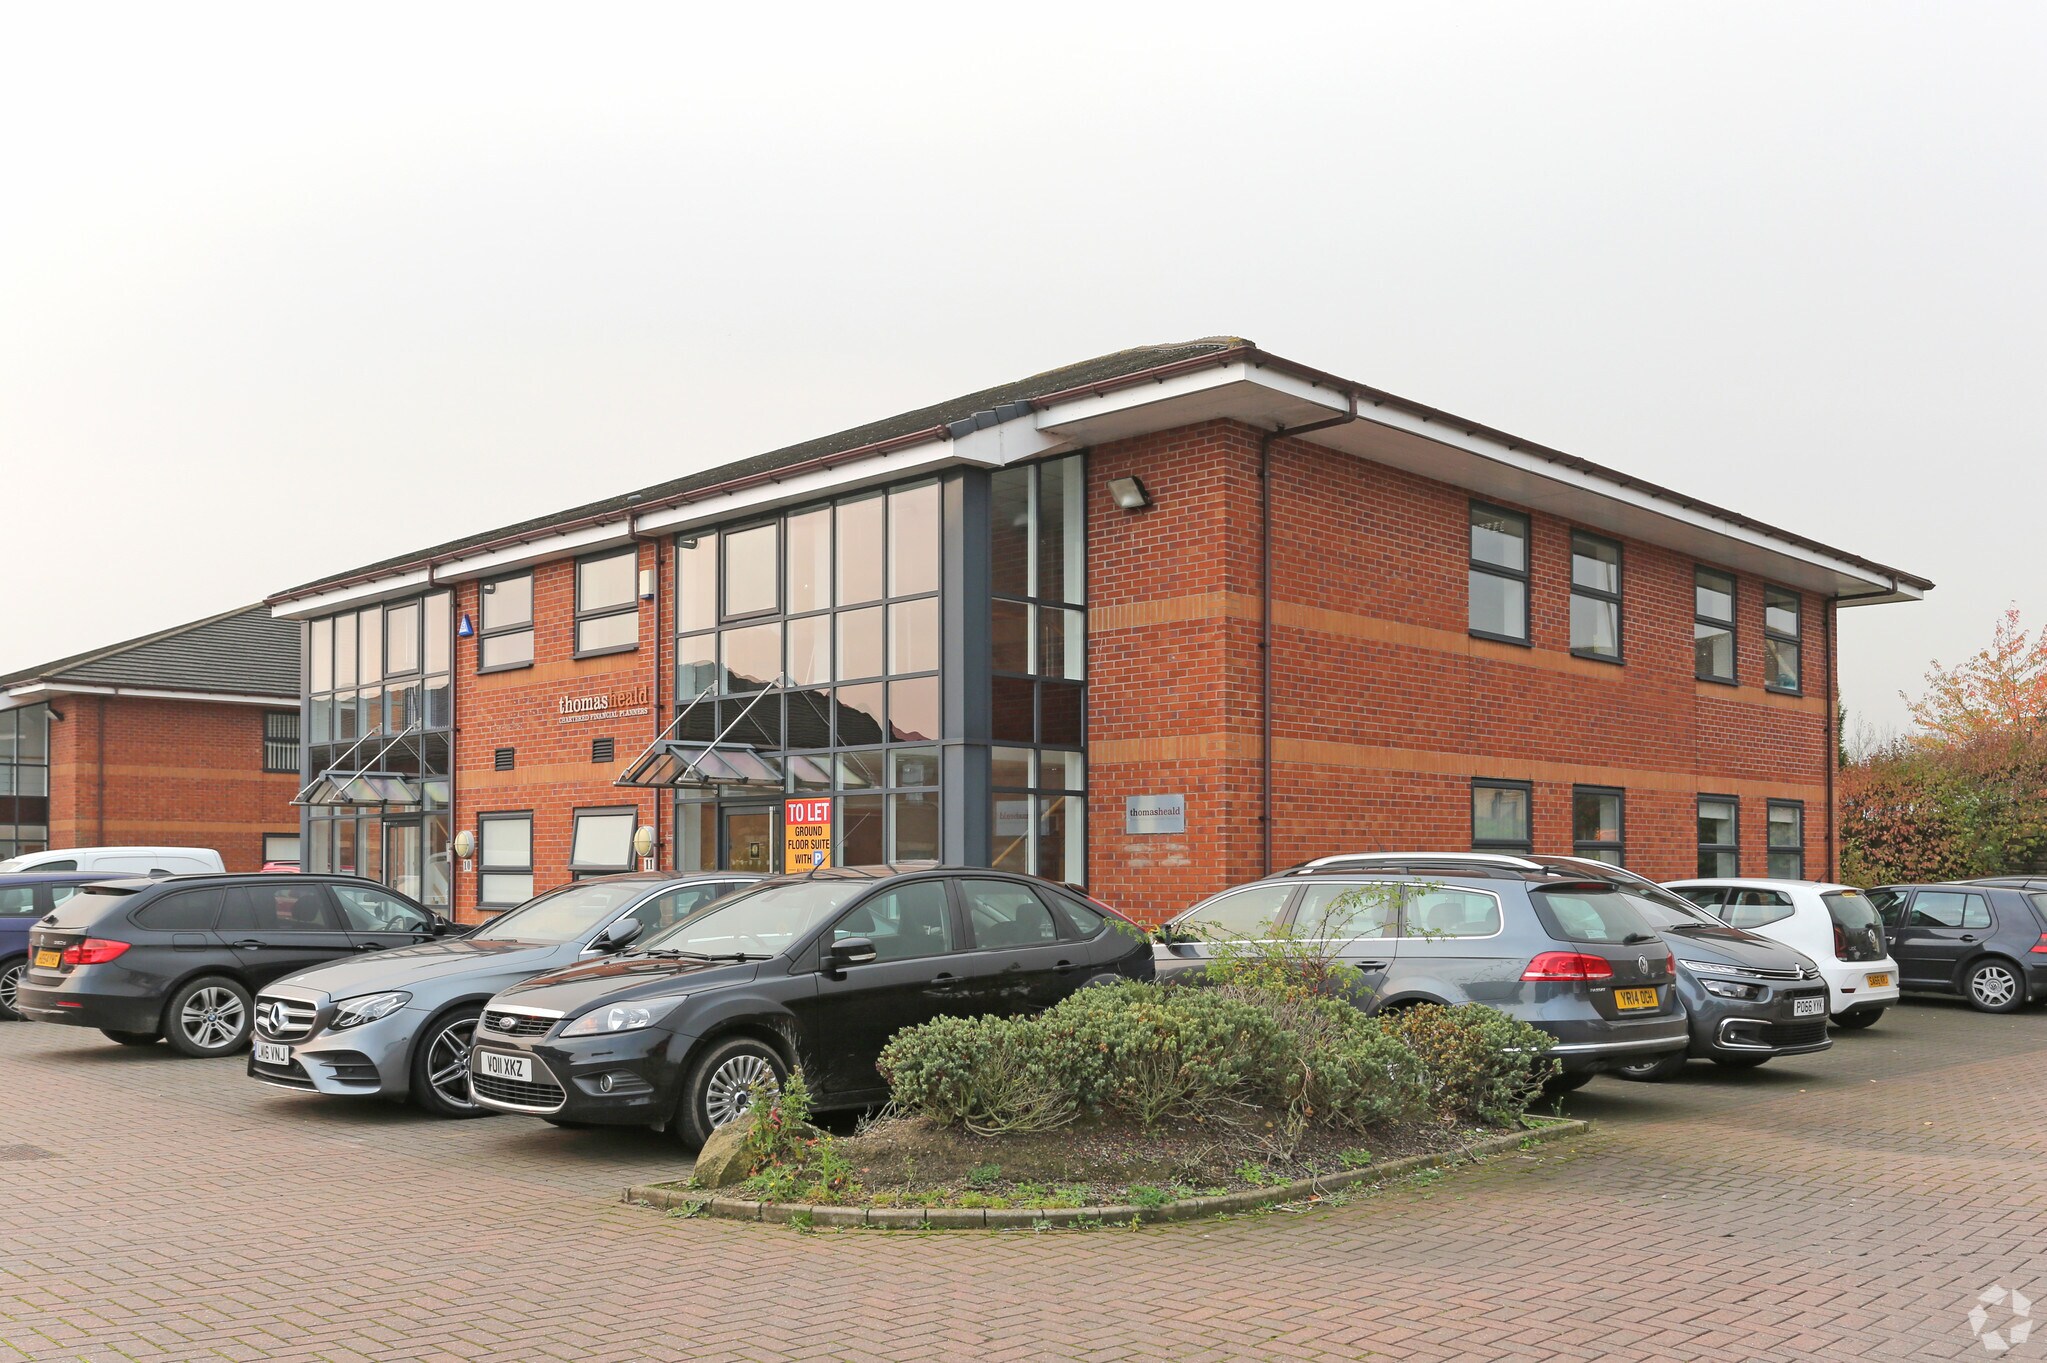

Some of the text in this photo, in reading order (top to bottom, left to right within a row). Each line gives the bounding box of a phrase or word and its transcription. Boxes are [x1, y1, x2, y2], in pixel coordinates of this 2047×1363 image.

[559, 685, 648, 714] thomasheald
[590, 710, 618, 720] FINANCIAL
[619, 707, 648, 718] PLANNERS
[788, 802, 829, 822] TO LET
[1130, 807, 1180, 816] thomasheald
[795, 826, 822, 836] GROUND
[788, 839, 829, 849] FLOOR SUITE
[646, 859, 653, 869] 11
[795, 854, 811, 863] WITH
[464, 861, 471, 870] 10
[1621, 991, 1639, 1005] YR14
[1797, 1001, 1812, 1013] PO66
[271, 1046, 285, 1061] VNJ
[488, 1055, 523, 1077] VO11 XKZ
